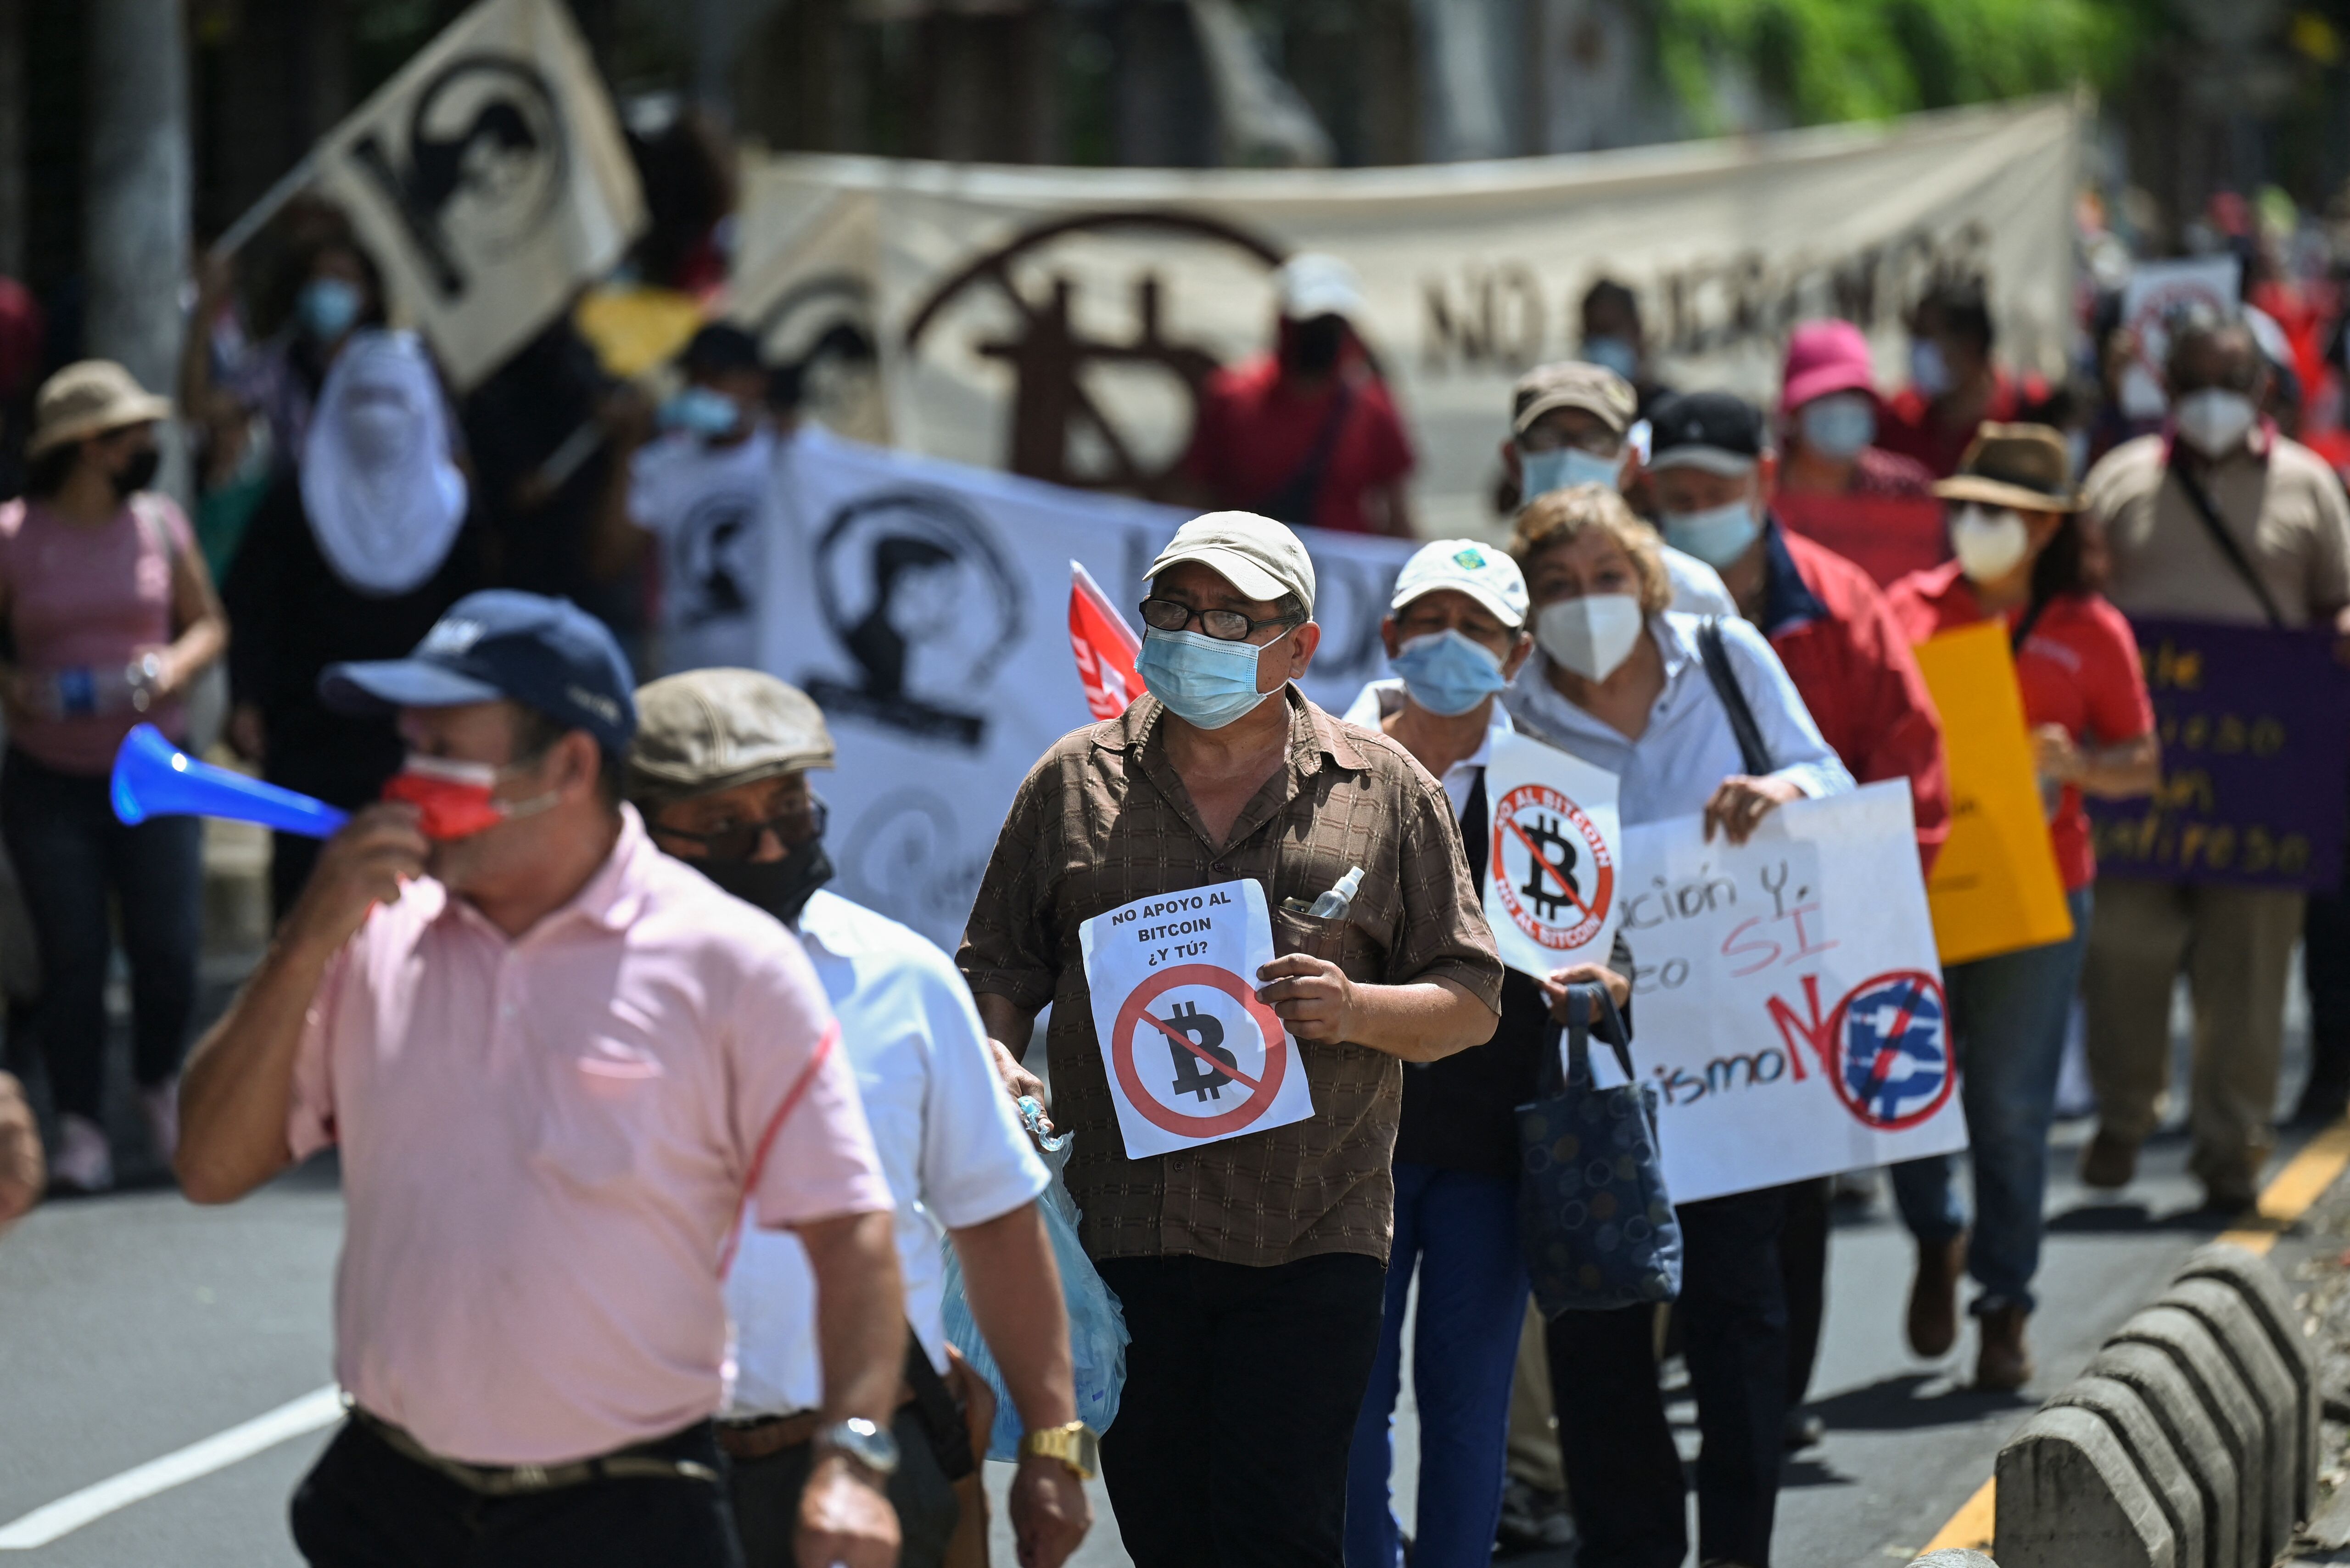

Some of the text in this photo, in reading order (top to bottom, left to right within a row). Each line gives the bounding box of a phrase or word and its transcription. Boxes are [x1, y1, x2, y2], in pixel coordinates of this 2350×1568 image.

[1516, 787, 1540, 808] AL
[1542, 789, 1611, 868] BITCOIN
[1112, 891, 1231, 926] NO APOYO AL
[1497, 877, 1603, 948] NO AL BITCOIN
[1138, 918, 1211, 942] BITCOIN
[1149, 941, 1208, 966] ¿Y TÚ?
